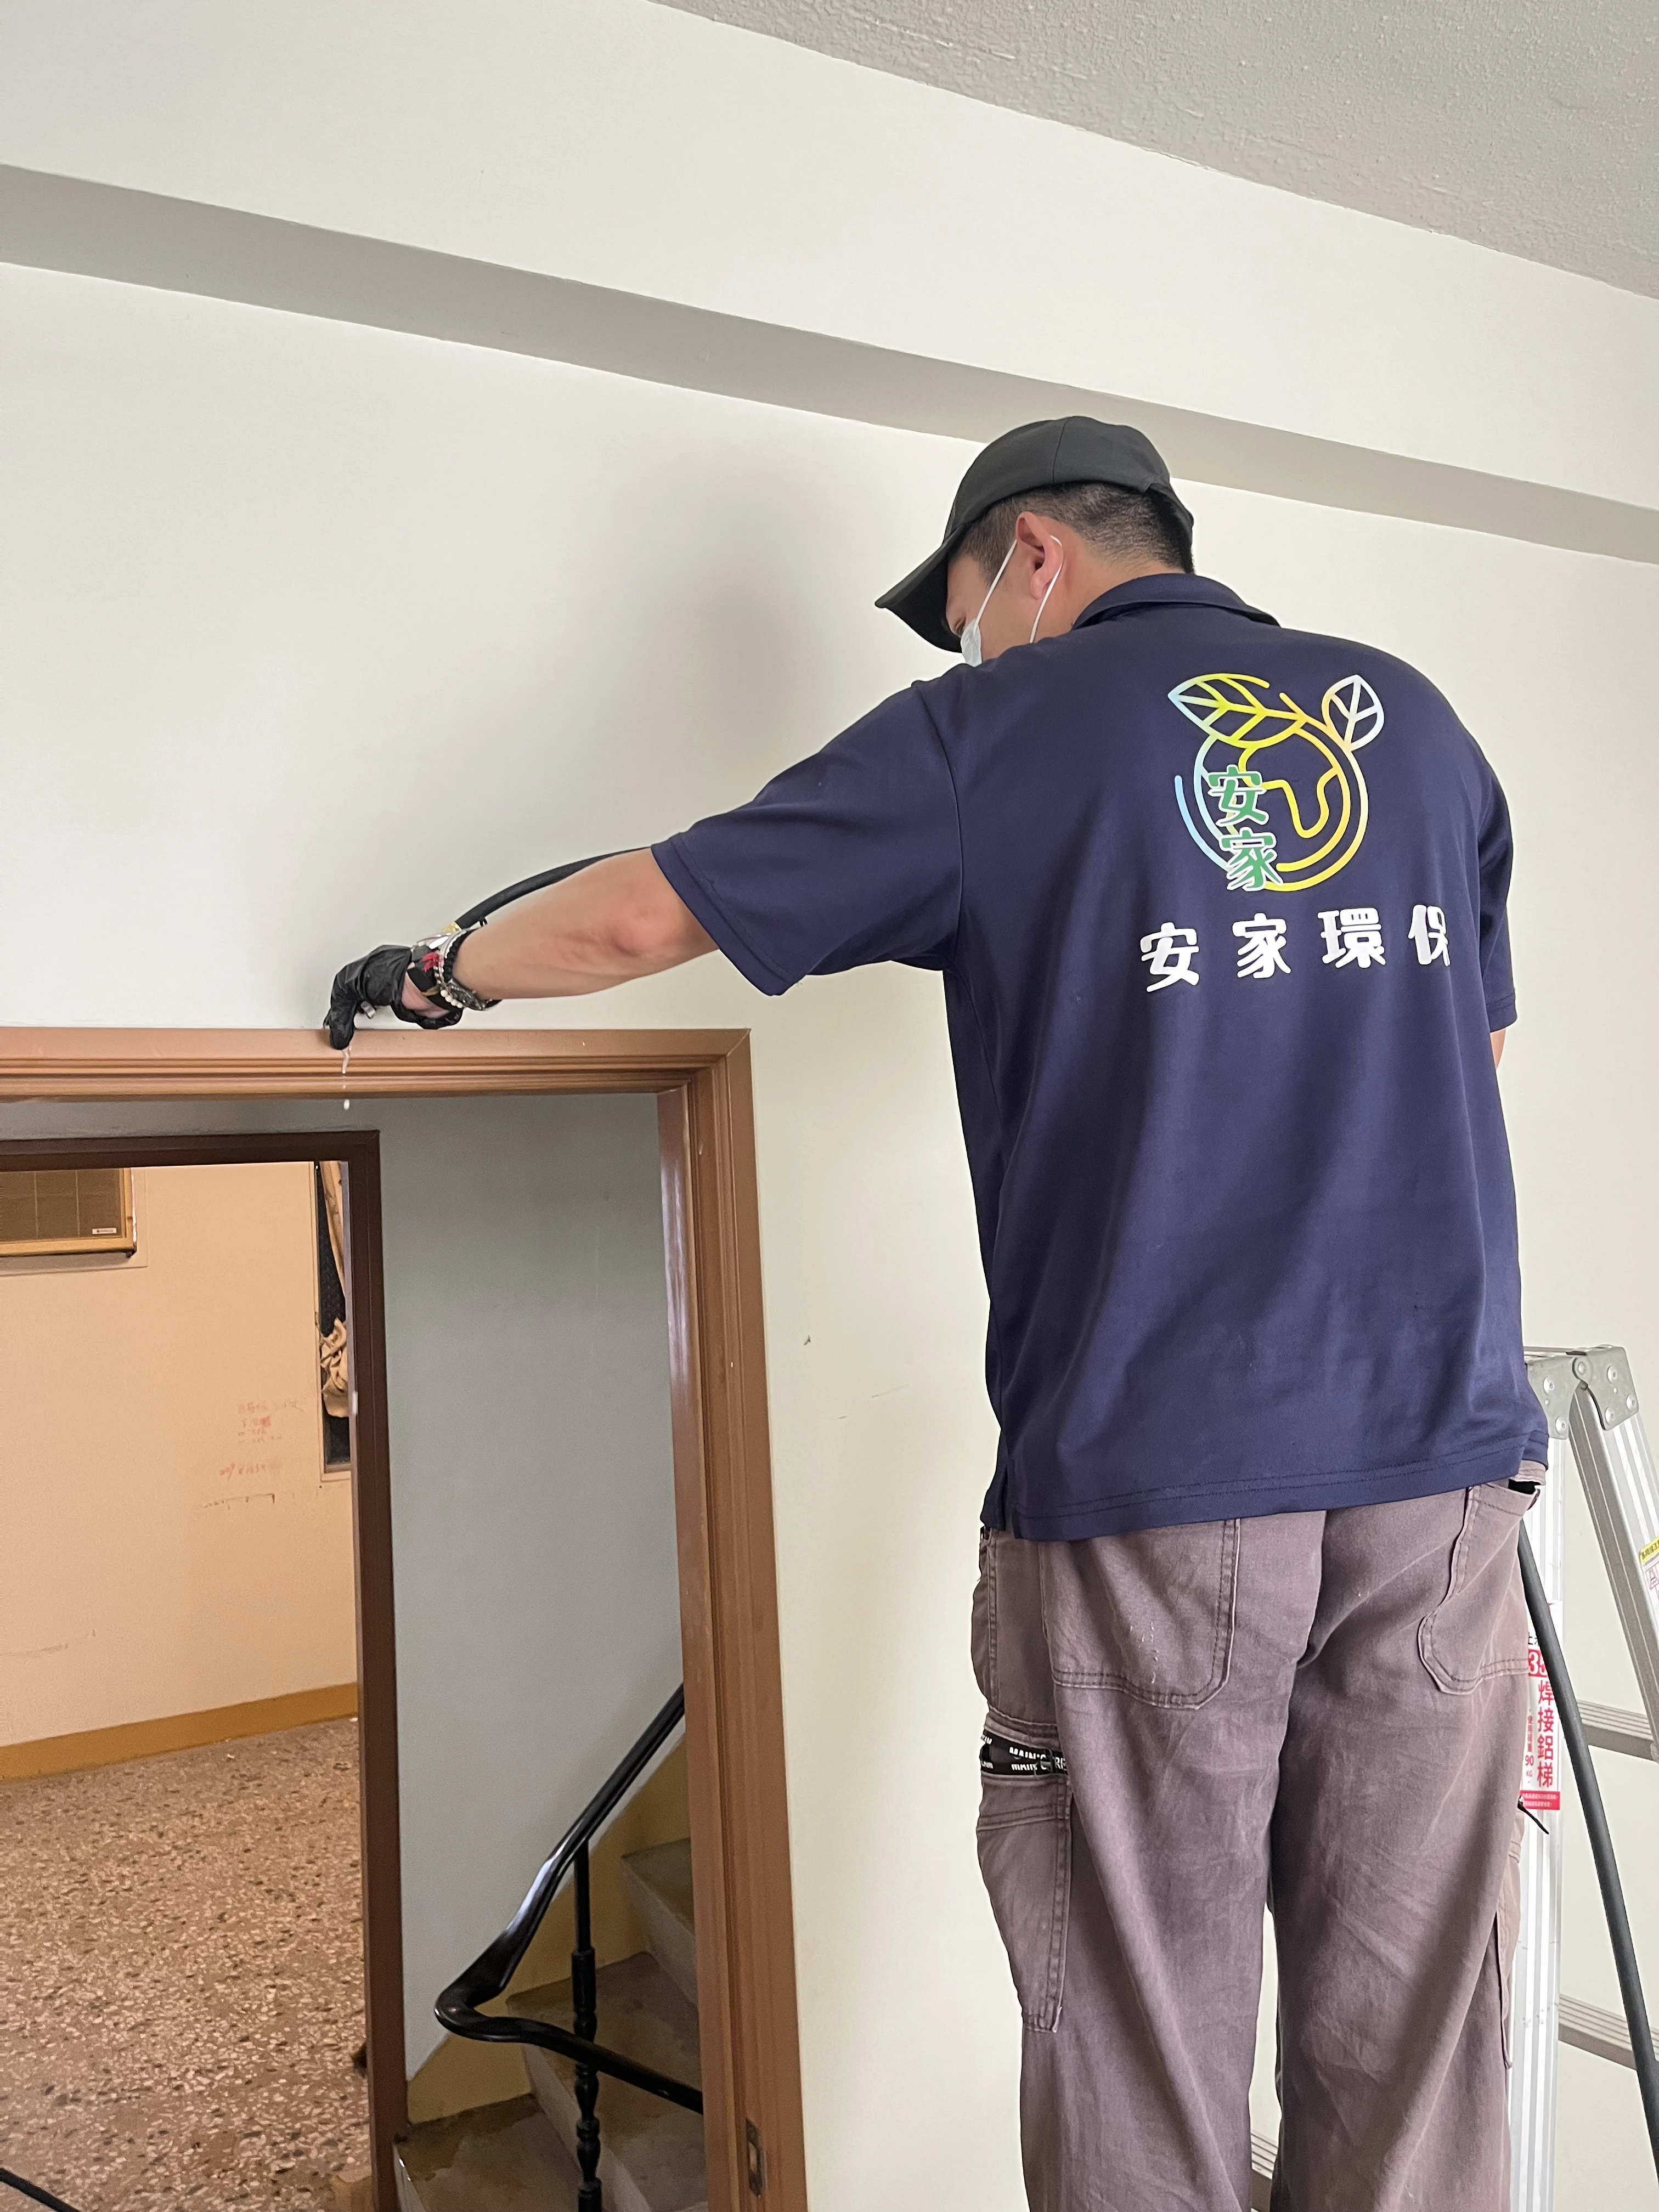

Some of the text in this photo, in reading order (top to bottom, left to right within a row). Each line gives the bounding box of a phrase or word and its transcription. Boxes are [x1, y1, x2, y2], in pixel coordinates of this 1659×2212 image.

[1208, 764, 1283, 891] 安家
[1140, 904, 1451, 992] 安家環保
[1525, 1754, 1534, 1766] 90
[1537, 1679, 1554, 1787] 焊接鋁梯
